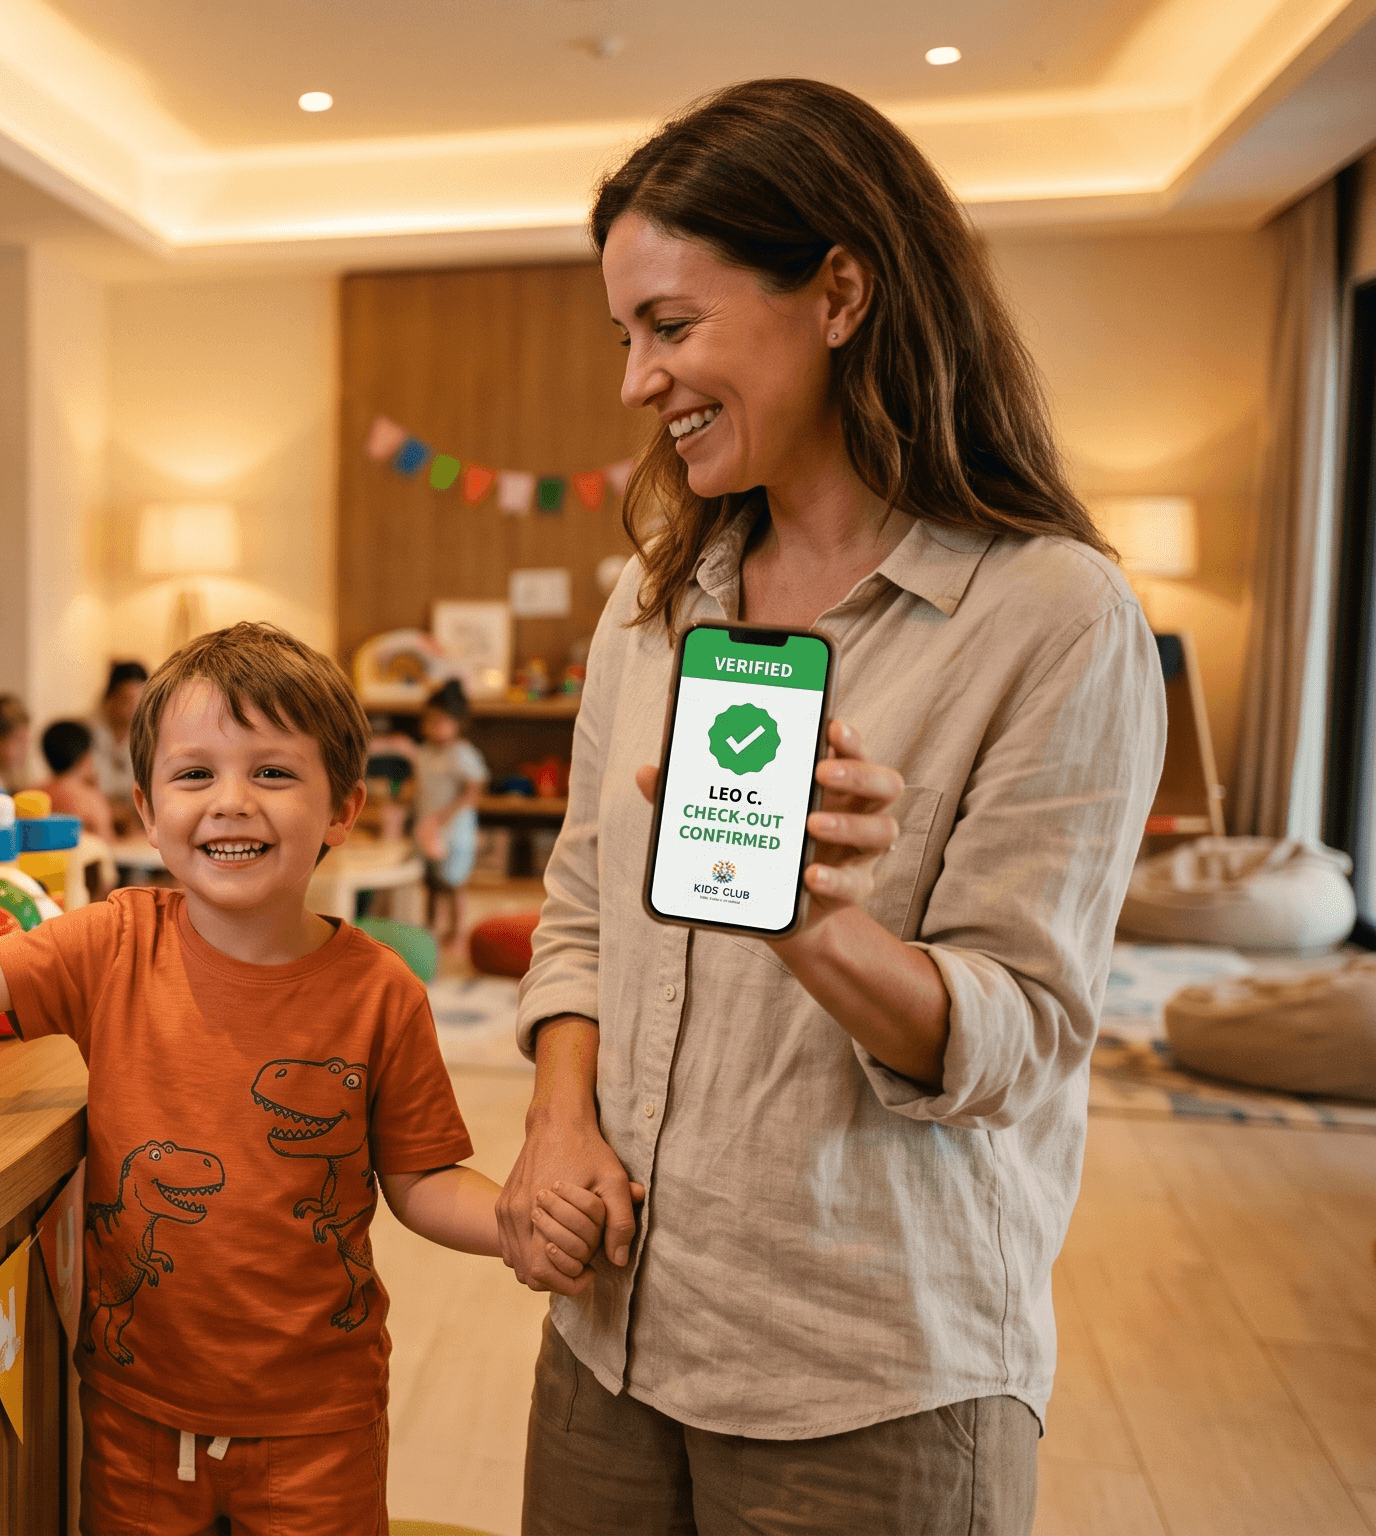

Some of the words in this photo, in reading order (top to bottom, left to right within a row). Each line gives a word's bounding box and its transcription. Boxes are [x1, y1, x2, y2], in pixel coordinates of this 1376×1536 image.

[713, 656, 793, 679] VERIFIED
[708, 785, 742, 802] LEO
[746, 790, 763, 805] C.
[682, 804, 784, 829] CHECK-OUT
[679, 825, 781, 850] CONFIRMED
[722, 887, 750, 900] CLUB
